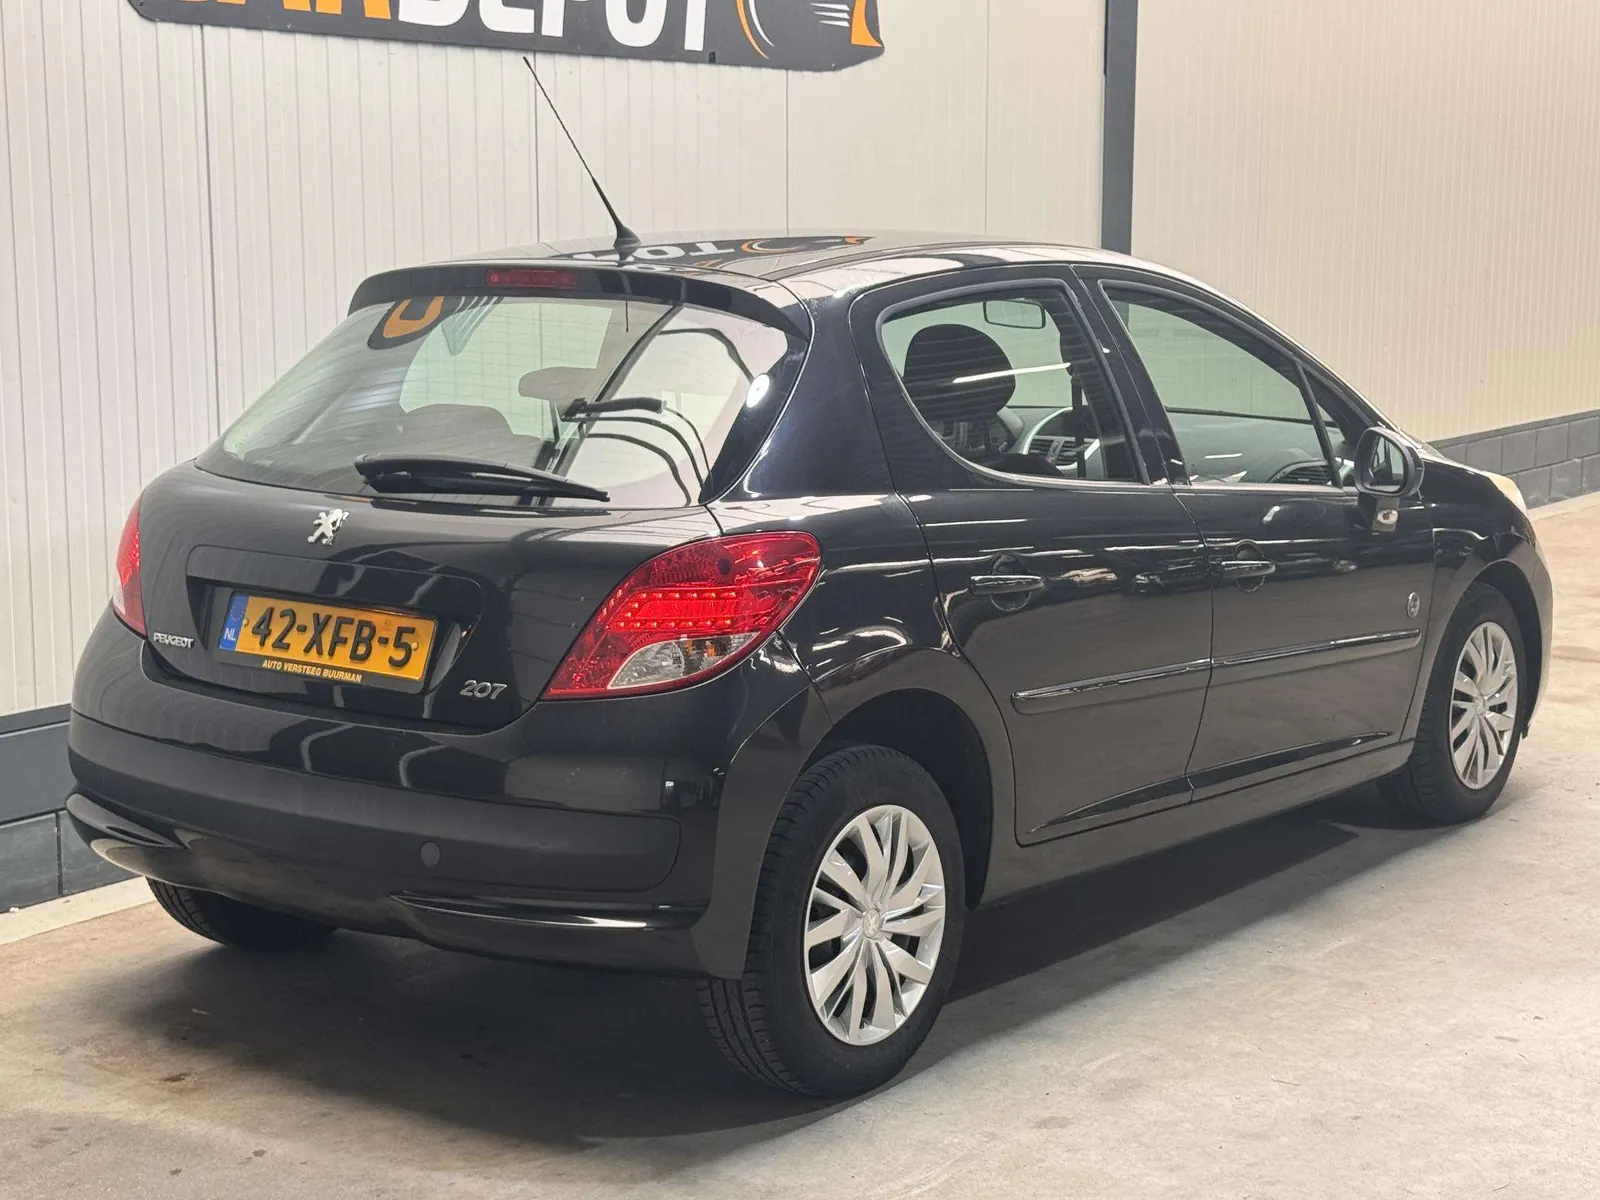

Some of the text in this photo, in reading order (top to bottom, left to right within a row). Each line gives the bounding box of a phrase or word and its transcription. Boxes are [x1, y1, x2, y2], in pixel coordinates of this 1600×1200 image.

[153, 632, 194, 649] PEUGEOT
[223, 627, 237, 641] NL
[252, 607, 416, 668] 42-XFB-5
[262, 659, 362, 683] AUTO VERSTEEG BUURMAN
[460, 679, 508, 700] 207
